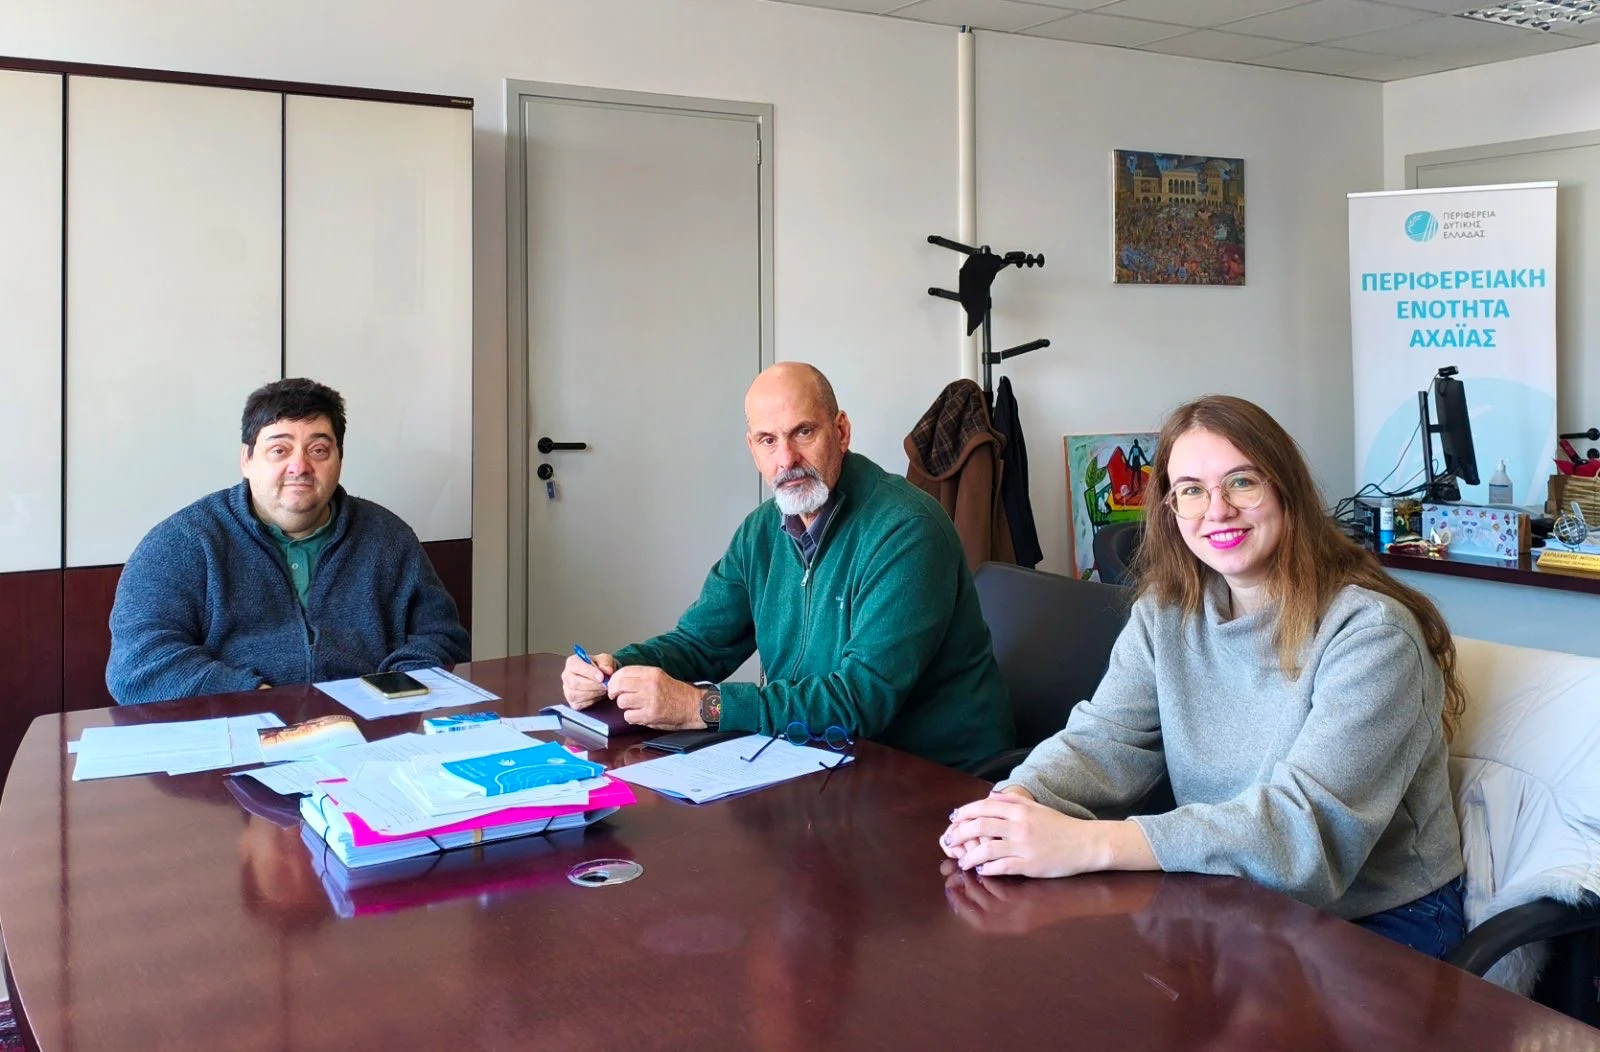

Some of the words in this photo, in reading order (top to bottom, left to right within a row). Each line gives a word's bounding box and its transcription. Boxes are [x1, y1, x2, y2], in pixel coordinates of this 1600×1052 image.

[1443, 210, 1496, 220] ΠΕΡΙΦΕΡΕΙΑ
[1443, 220, 1482, 229] ΔΥΤΙΚΗΣ
[1443, 230, 1486, 239] ΕΛΛΑΔΑΣ
[1361, 268, 1546, 291] ΠΕΡΙΦΕΡΕΙΑΚΗ
[1396, 299, 1510, 319] ΕΝΟΤΗΤΑ
[1409, 323, 1497, 347] ΑΧΑΪΑΣ
